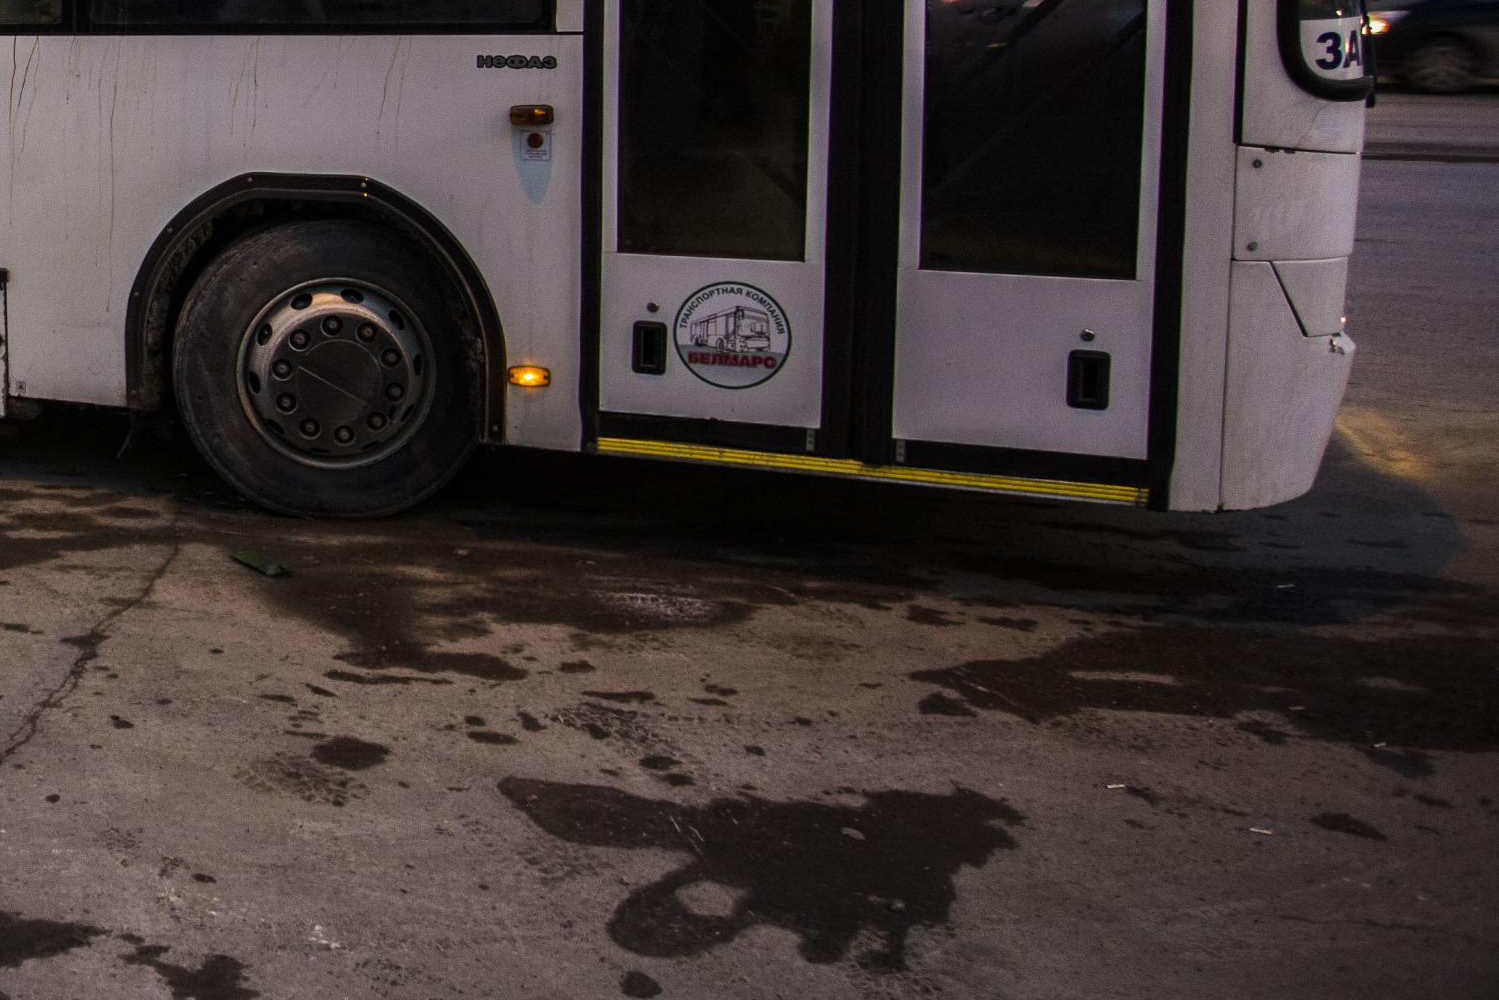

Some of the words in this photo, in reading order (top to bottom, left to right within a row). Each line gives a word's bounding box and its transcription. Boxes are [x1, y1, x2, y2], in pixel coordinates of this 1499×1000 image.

[679, 286, 744, 329] ТРАНСПОРТНАЯ
[745, 289, 786, 335] КОМПАНИЯ
[687, 350, 777, 370] БЕЛМАРО
